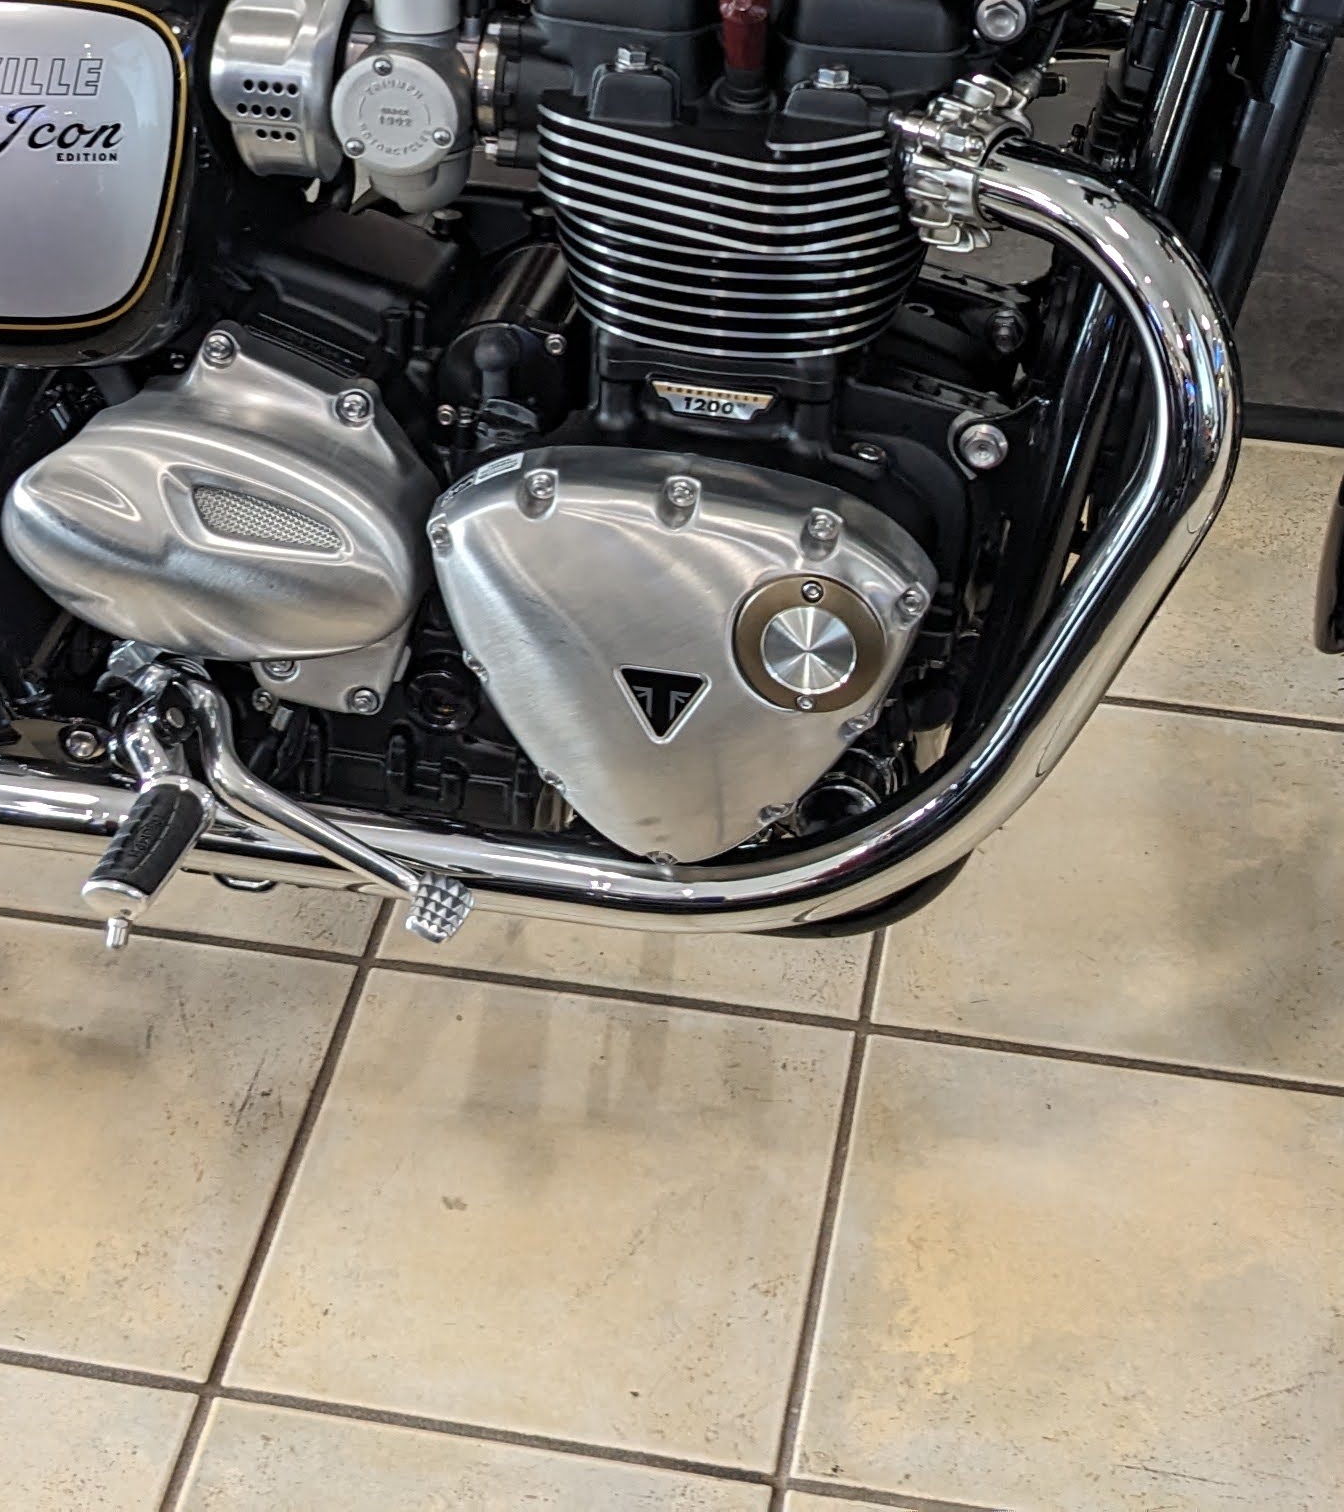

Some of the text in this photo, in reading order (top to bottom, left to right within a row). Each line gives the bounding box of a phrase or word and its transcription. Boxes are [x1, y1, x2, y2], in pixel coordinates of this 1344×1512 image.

[366, 79, 424, 100] TRIUMPH
[57, 152, 118, 162] EDITION
[684, 396, 734, 414] 1200
